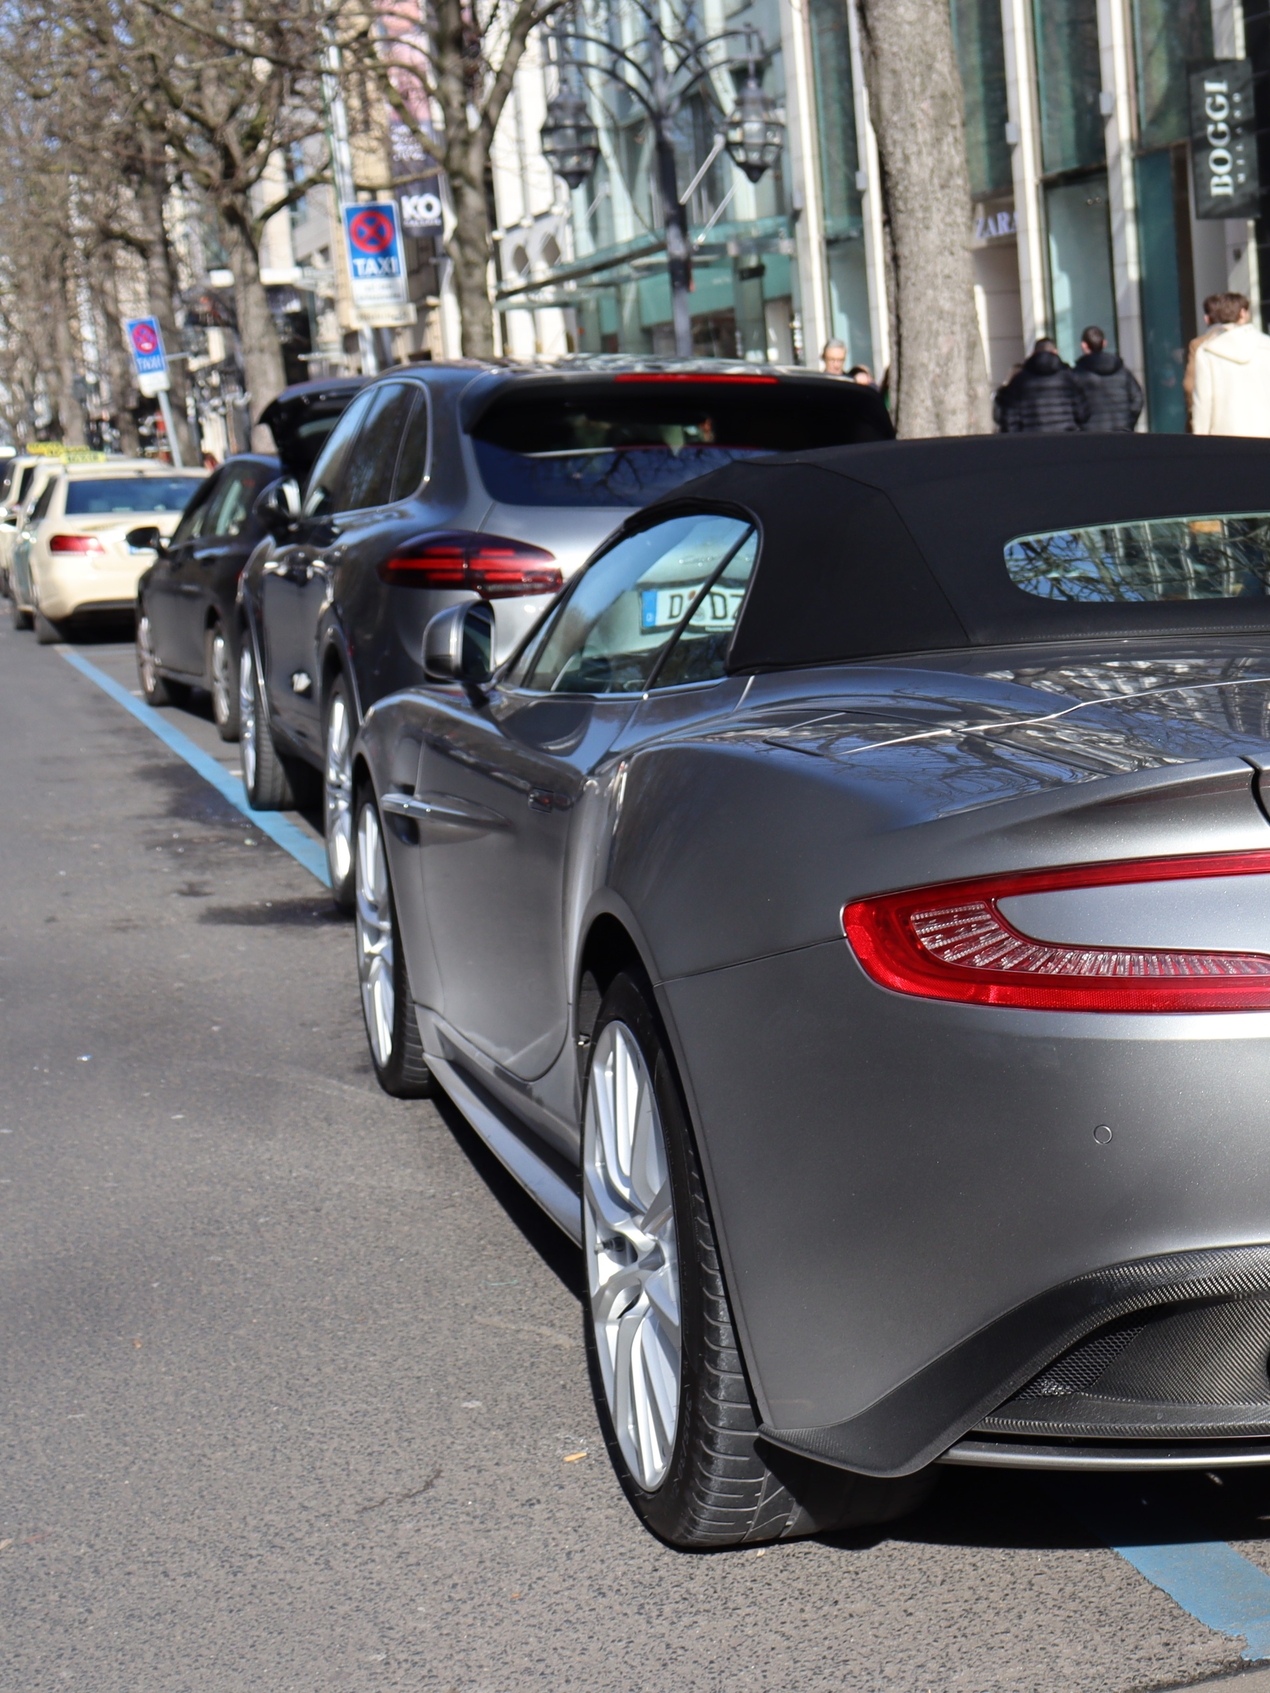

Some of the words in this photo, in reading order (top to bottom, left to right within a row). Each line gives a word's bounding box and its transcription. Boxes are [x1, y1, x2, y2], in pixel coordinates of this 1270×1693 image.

[1203, 79, 1235, 197] BOGGI
[353, 256, 399, 277] TAXI
[668, 594, 684, 619] D
